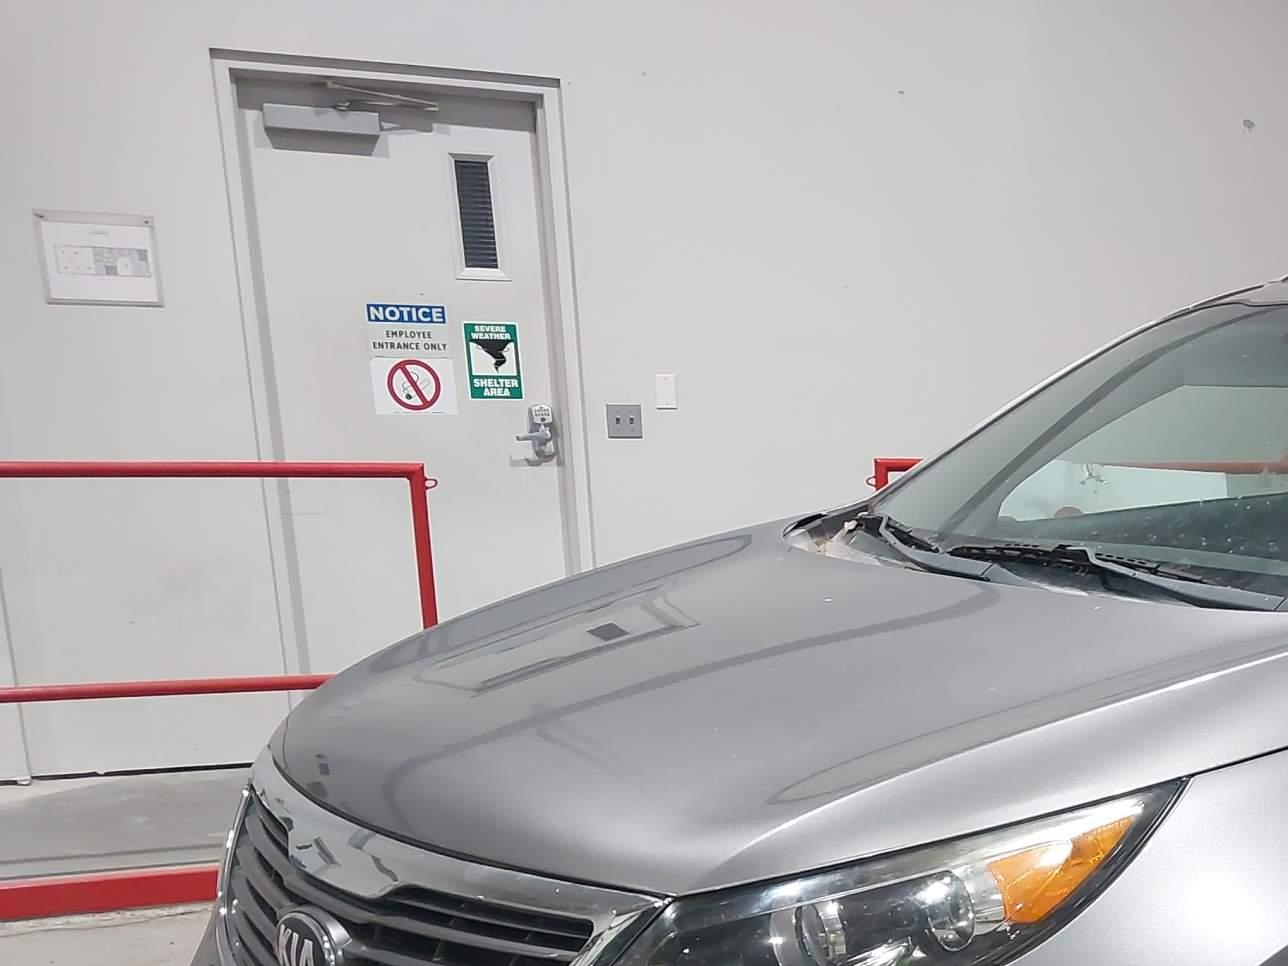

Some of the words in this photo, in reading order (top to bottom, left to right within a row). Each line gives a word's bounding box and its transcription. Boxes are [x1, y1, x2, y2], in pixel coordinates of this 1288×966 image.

[369, 306, 445, 323] NOTICE
[474, 325, 507, 333] SEVERE
[385, 330, 433, 340] EMPLOYEE
[471, 332, 512, 341] WEATHER
[373, 341, 421, 351] ENTRANCE
[423, 342, 448, 352] ONLY
[473, 378, 519, 388] SHELTER
[483, 387, 511, 397] AREA
